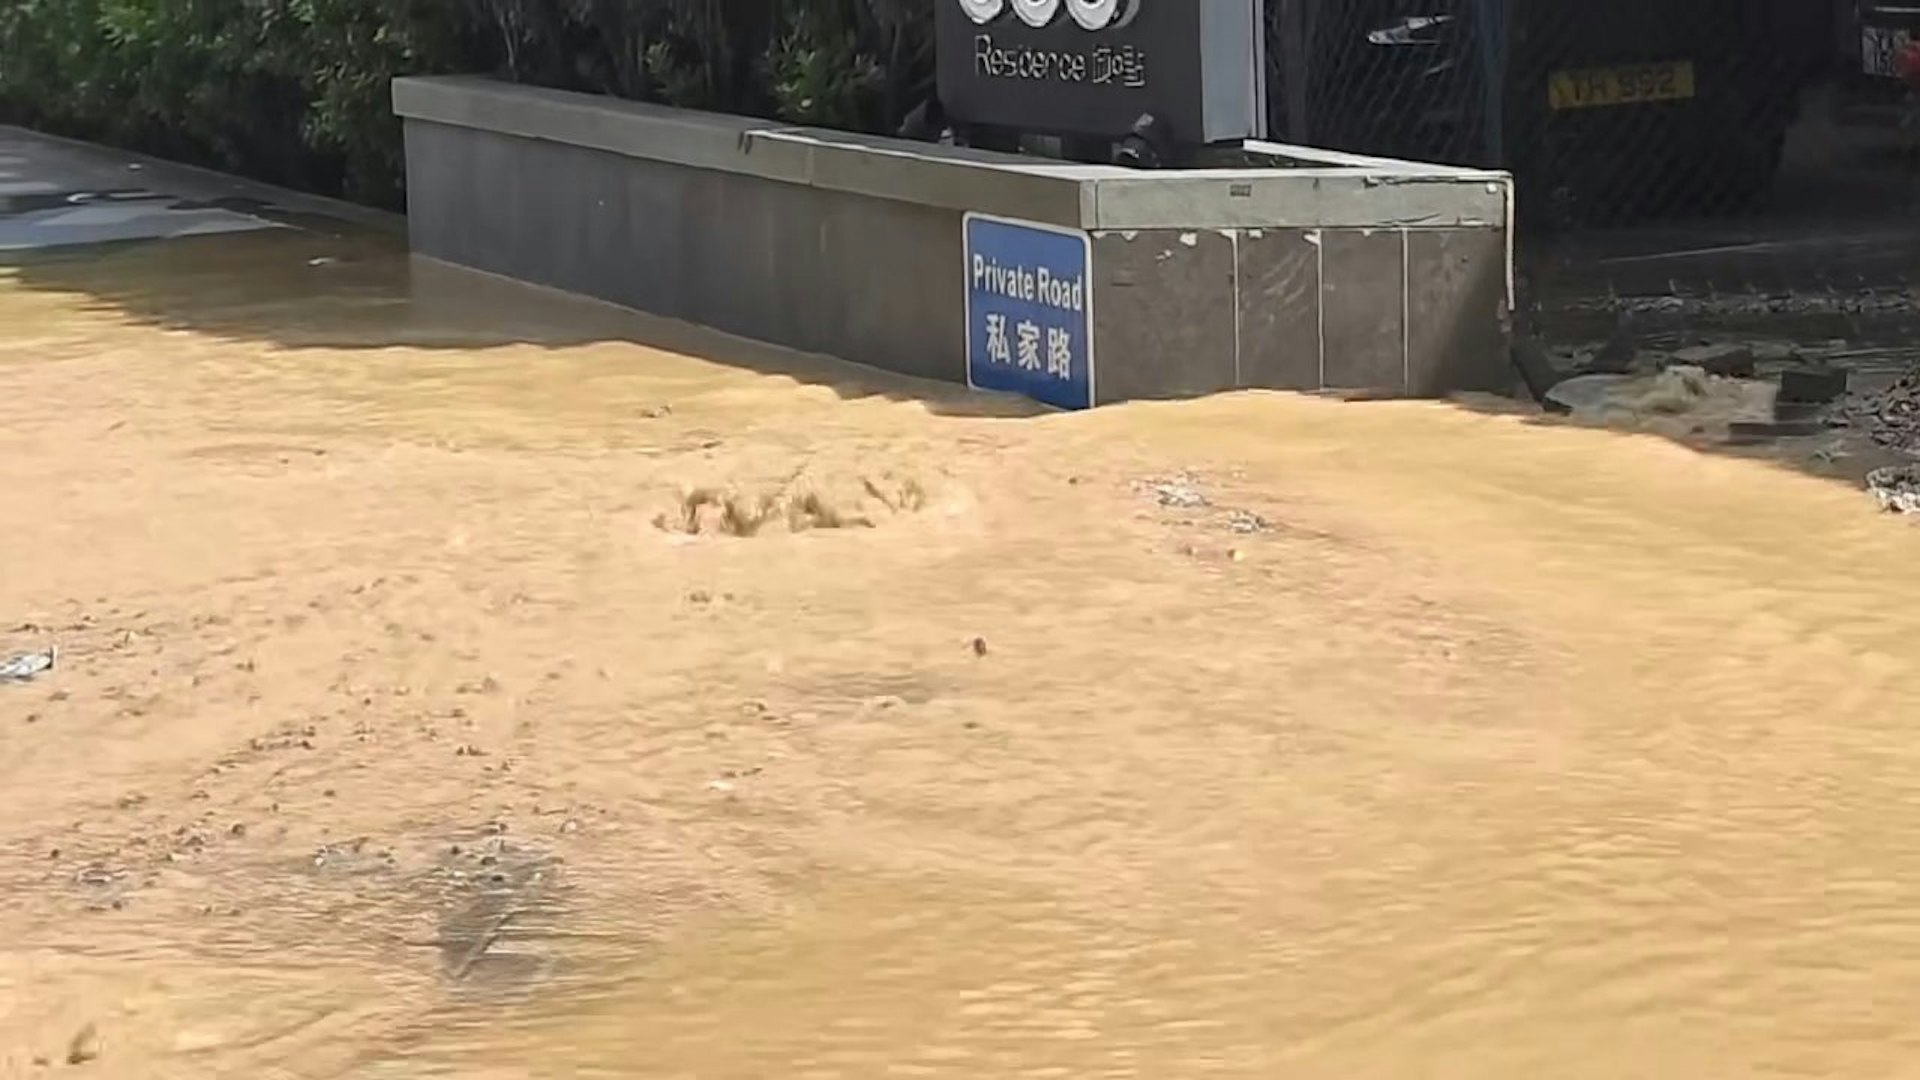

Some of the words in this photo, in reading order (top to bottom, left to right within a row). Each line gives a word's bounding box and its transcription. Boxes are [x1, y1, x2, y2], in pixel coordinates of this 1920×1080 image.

[972, 254, 1034, 300] Private
[1037, 266, 1083, 313] Road
[986, 313, 1072, 381] 私家路
